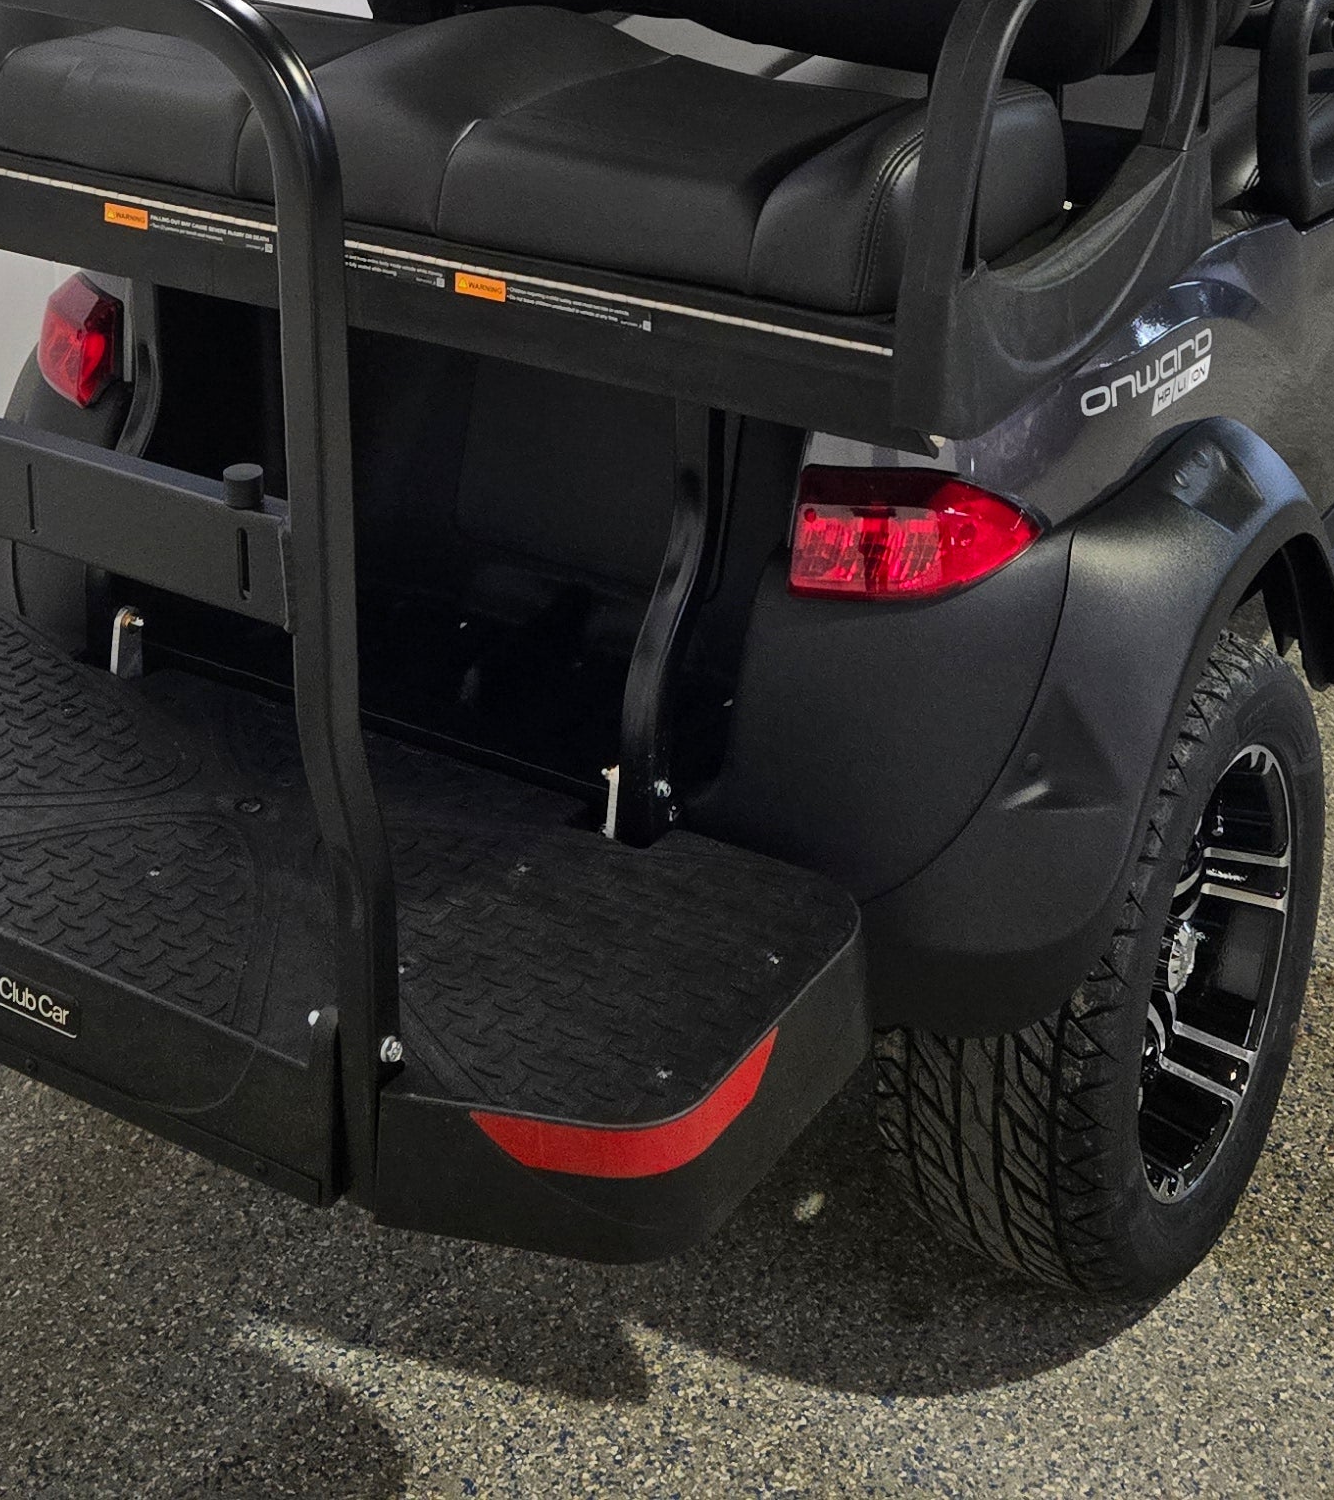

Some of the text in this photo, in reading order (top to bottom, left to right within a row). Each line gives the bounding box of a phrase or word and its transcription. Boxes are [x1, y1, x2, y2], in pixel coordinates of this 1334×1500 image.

[115, 211, 146, 224] WARNING
[468, 282, 503, 295] WARNING
[38, 994, 70, 1026] Car
